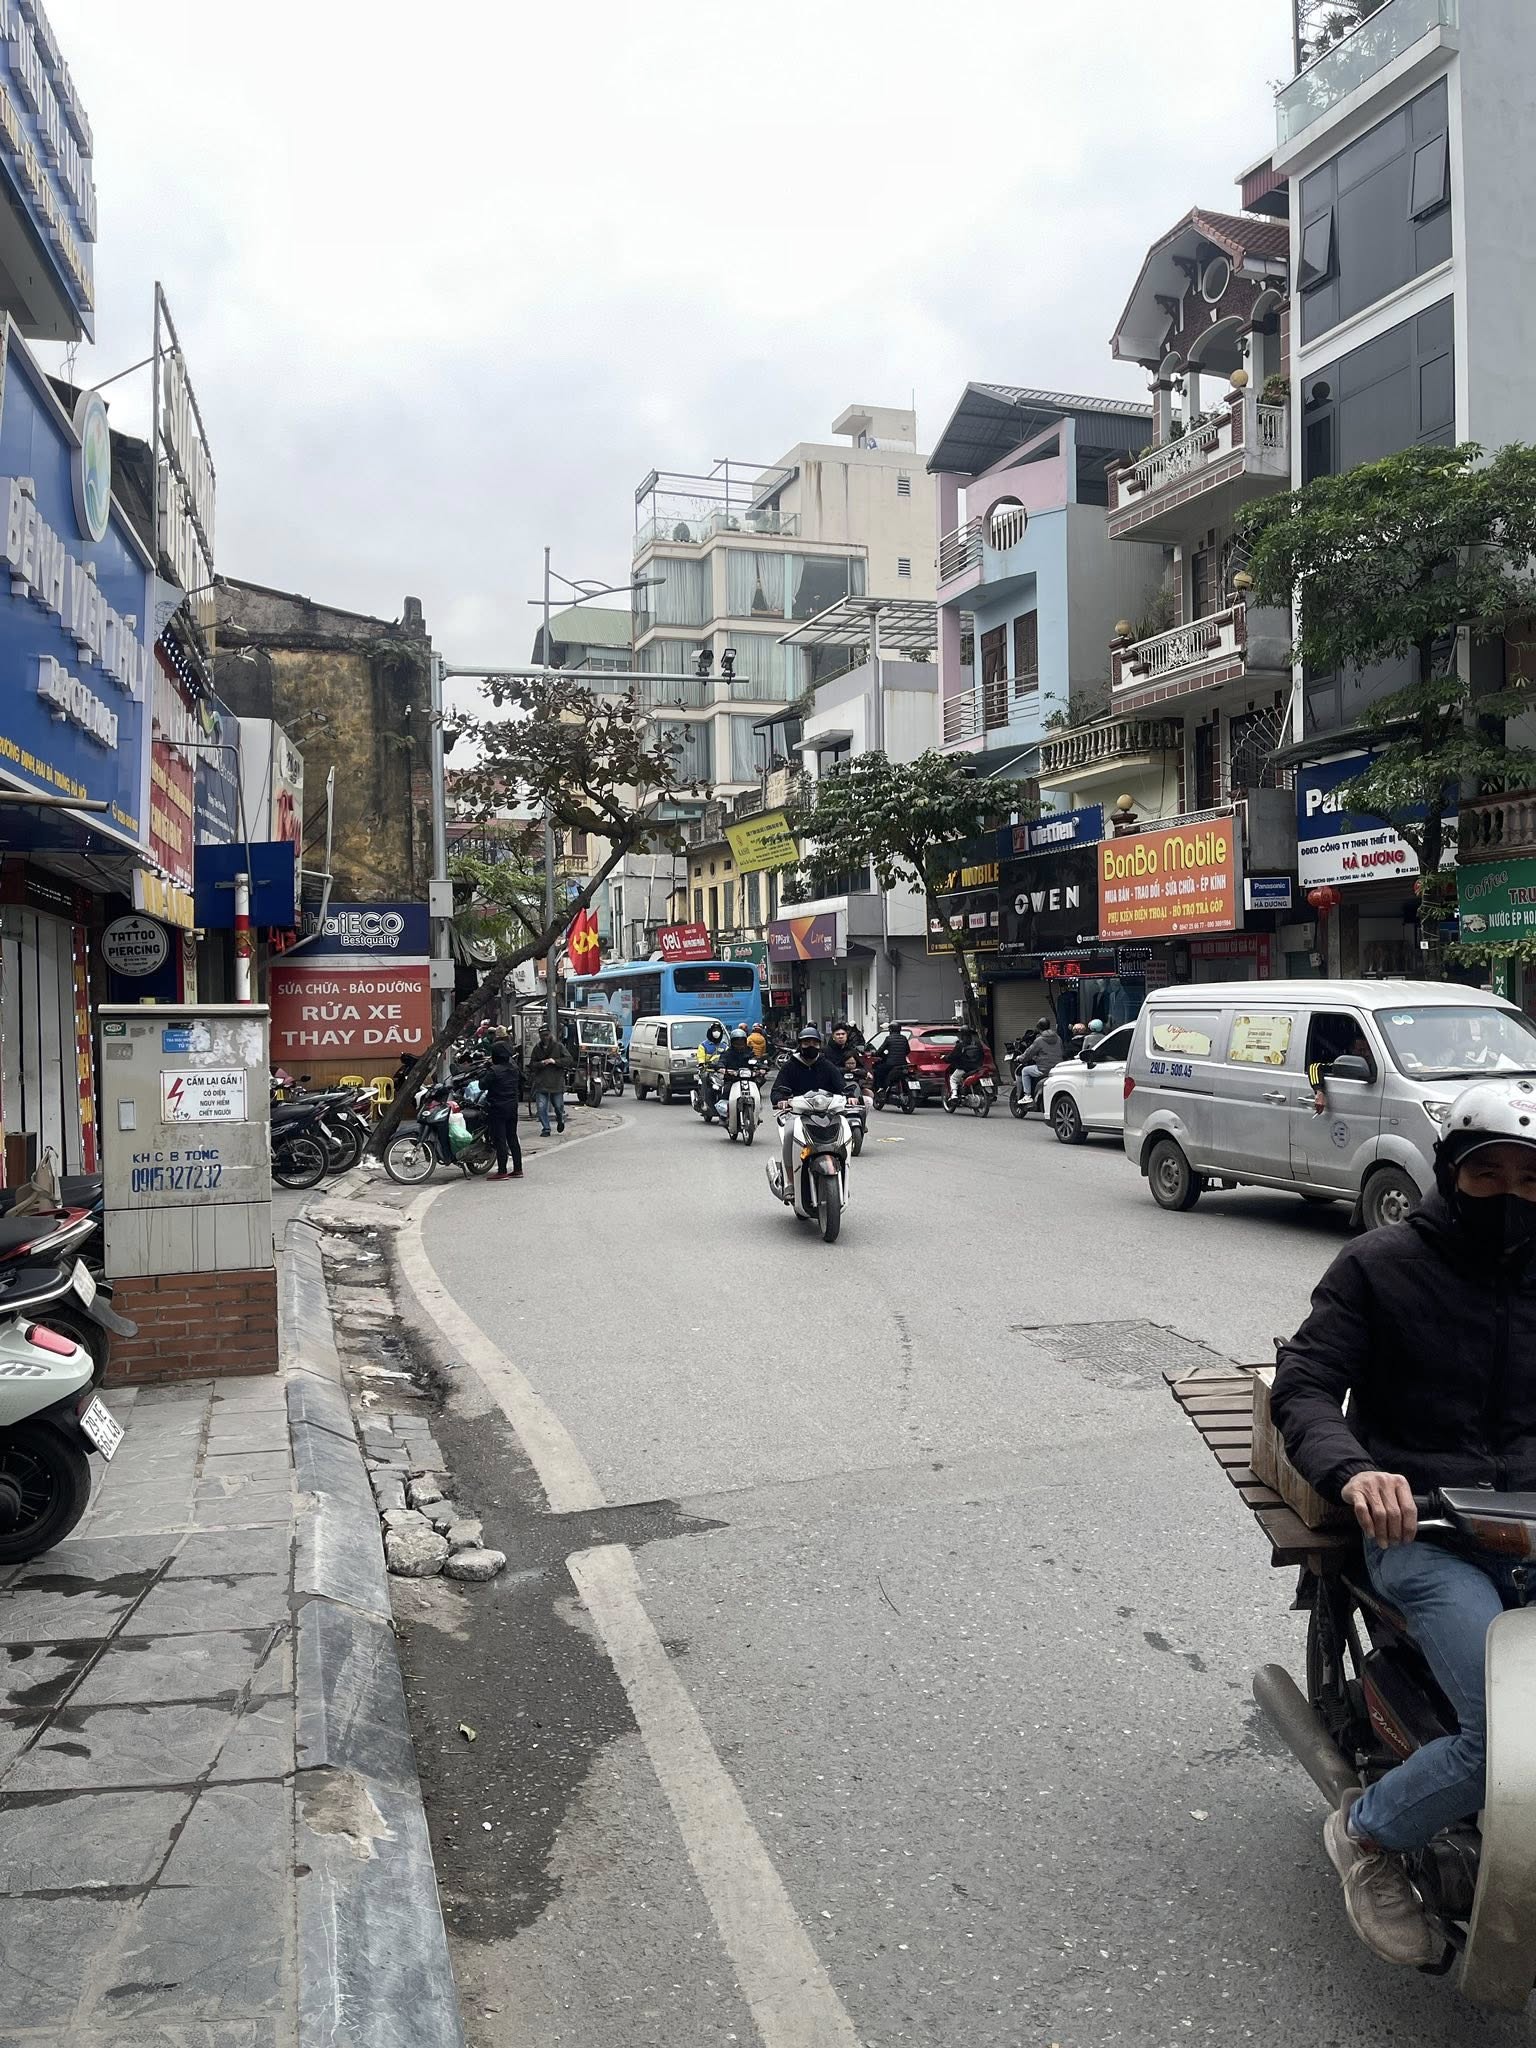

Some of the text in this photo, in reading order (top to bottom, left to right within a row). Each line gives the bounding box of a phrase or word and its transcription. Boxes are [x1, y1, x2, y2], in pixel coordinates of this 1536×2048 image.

[0, 477, 65, 615] BỆNH
[62, 560, 107, 664] VIỆN
[38, 654, 92, 729] BẠCH
[1320, 843, 1340, 853] CÔNG
[1342, 841, 1350, 849] TY
[1351, 840, 1368, 848] TNHH
[1370, 833, 1387, 845] THIẾT
[1104, 831, 1226, 881] BonBo Mobile
[1343, 849, 1405, 870] HÀ DƯƠNG
[961, 862, 999, 887] MOBILE
[1104, 889, 1117, 904] MUA
[1118, 885, 1130, 902] BÁN
[1134, 885, 1148, 900] TRAO
[1150, 878, 1160, 899] ĐỔI
[1165, 876, 1177, 896] SỬA
[1179, 876, 1195, 895] CHỮA
[1200, 873, 1208, 892] ÉP
[1210, 873, 1226, 890] KÍNH
[1254, 882, 1286, 890] Panasonic
[1465, 871, 1508, 901] Coffee
[1014, 885, 1080, 915] OWEN
[1108, 911, 1119, 925] PHỤ
[1120, 908, 1133, 924] KIỆN
[1134, 906, 1148, 923] ĐIỆN
[1149, 906, 1167, 920] THOẠI
[1173, 899, 1181, 917] HỖ
[1182, 901, 1195, 918] TRỢ
[1196, 898, 1209, 915] TRẢ
[1210, 897, 1223, 912] GÓP
[1489, 910, 1510, 928] NƯỚC
[1511, 909, 1522, 926] ÉP
[110, 930, 155, 942] TATTOO
[341, 934, 400, 948] Best quality
[662, 931, 681, 950] deli
[108, 944, 160, 957] PIERCING
[278, 980, 301, 995] SỬA
[305, 981, 340, 995] CHỮA
[350, 980, 374, 994] BẢO
[377, 980, 422, 994] DƯỠNG
[302, 1001, 402, 1021] RỬA XE
[281, 1024, 422, 1046] THAY DẦU
[1150, 1062, 1165, 1074] 29LD
[1171, 1064, 1192, 1077] 500.45
[187, 1074, 204, 1086] CẤM
[199, 1107, 212, 1116] CHẾT
[1372, 1706, 1409, 1750] Dream
